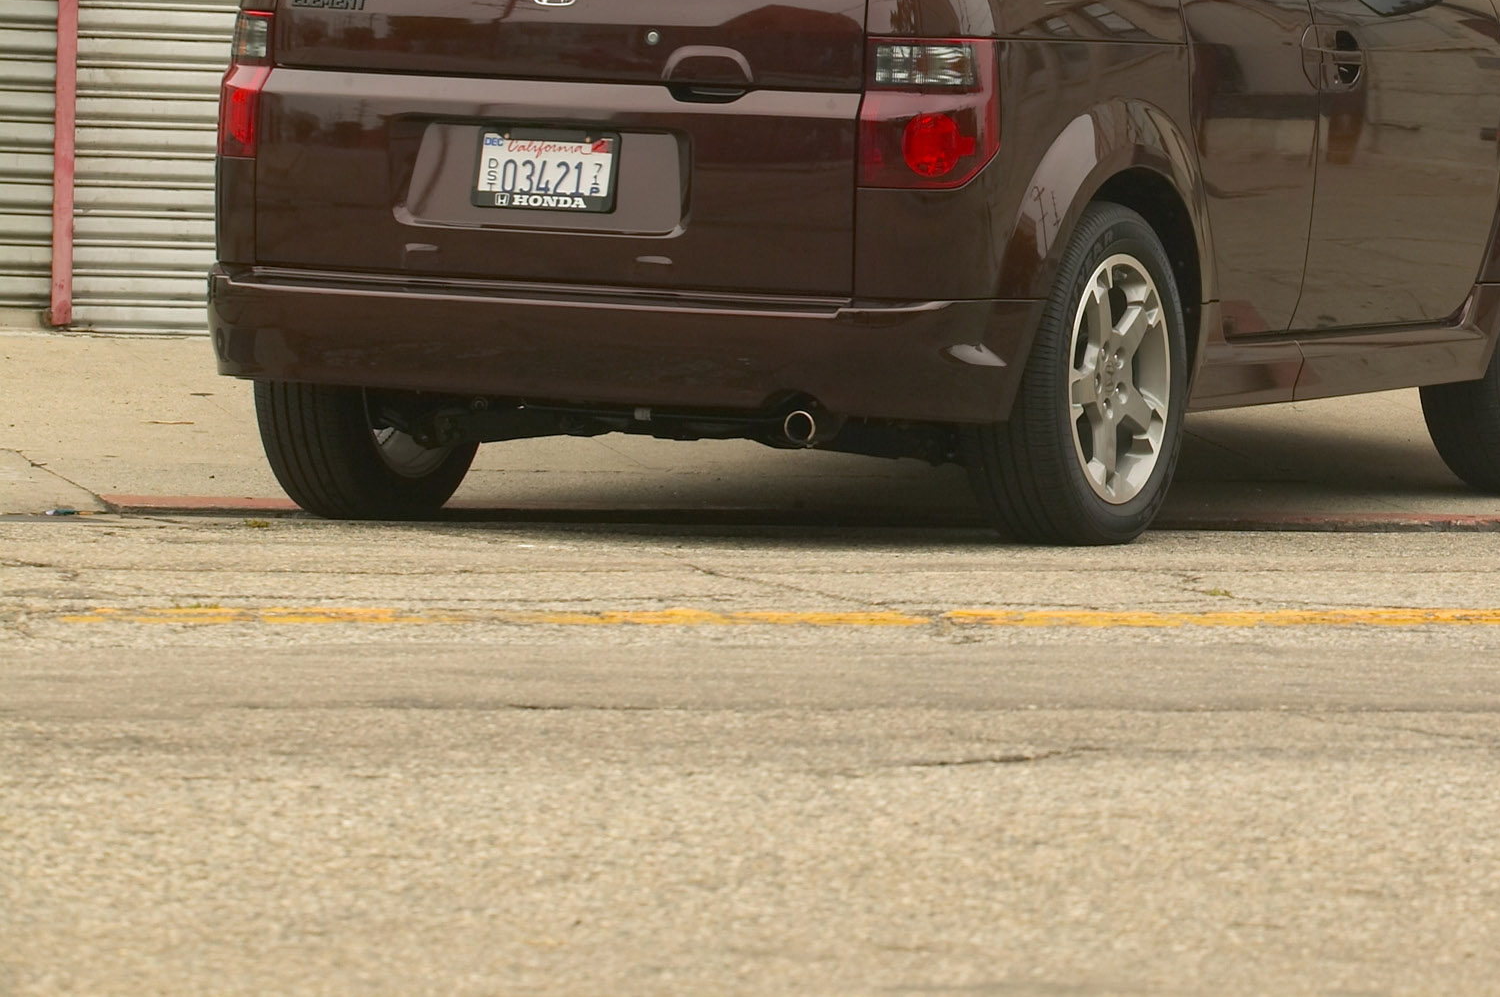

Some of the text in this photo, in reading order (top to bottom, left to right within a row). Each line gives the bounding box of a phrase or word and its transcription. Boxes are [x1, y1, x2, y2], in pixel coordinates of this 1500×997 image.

[484, 137, 504, 146] DEC
[507, 140, 592, 158] California
[501, 158, 585, 195] 03421
[512, 194, 587, 208] HONDA
